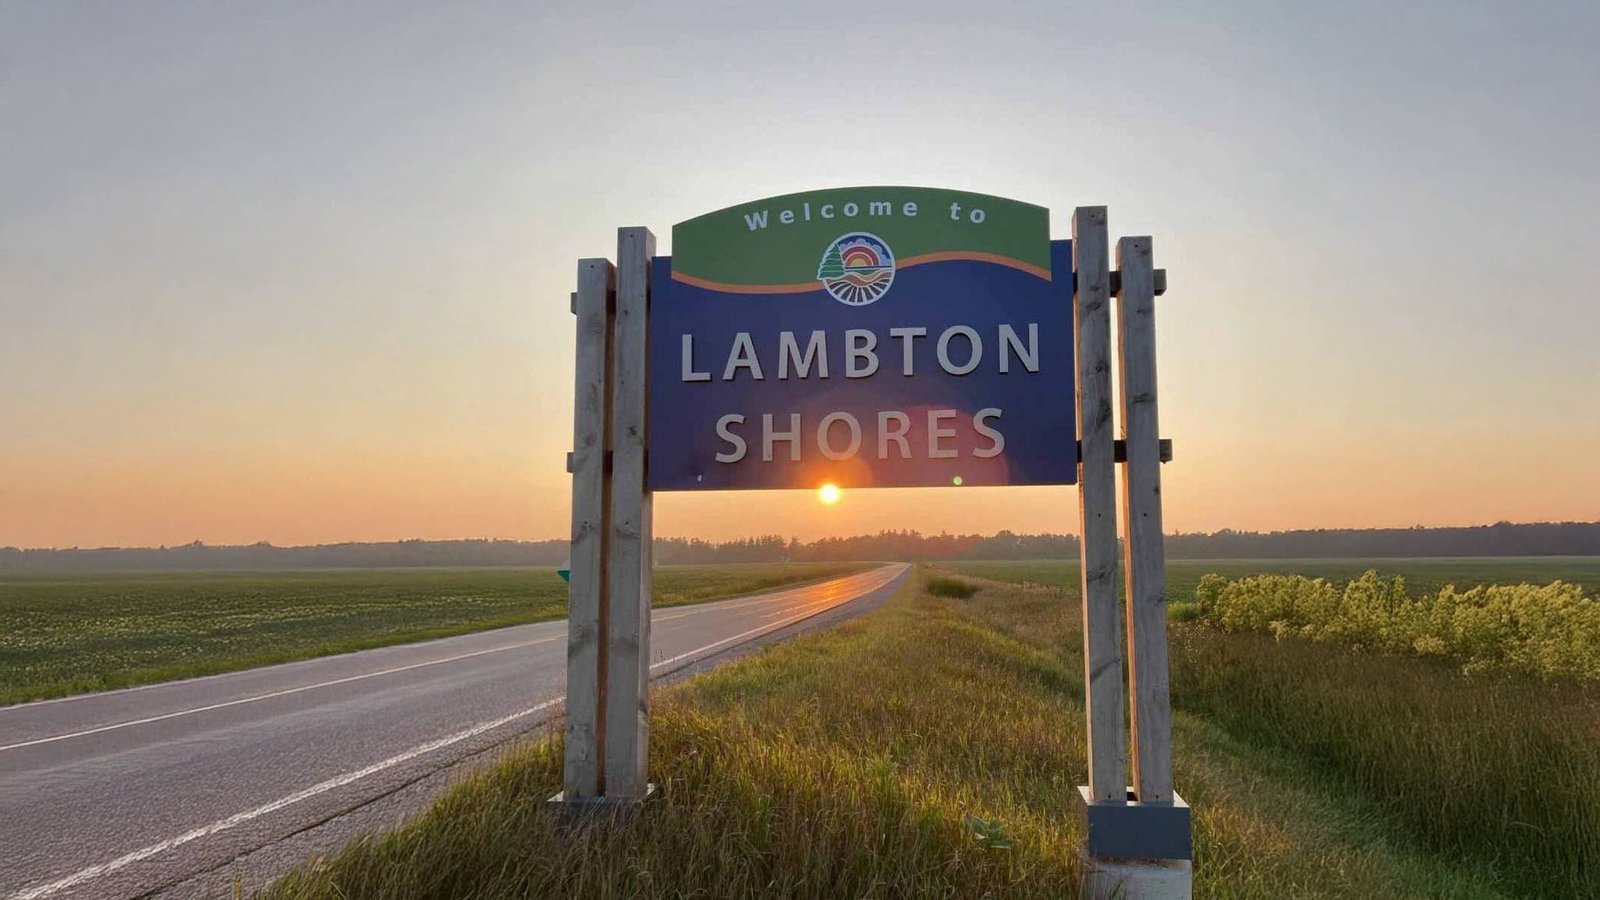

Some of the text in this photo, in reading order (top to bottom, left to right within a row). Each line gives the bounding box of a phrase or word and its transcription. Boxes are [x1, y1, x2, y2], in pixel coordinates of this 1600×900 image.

[744, 199, 987, 231] Welcome to
[681, 323, 1040, 382] LAMBTON
[715, 407, 1006, 463] SHORES
